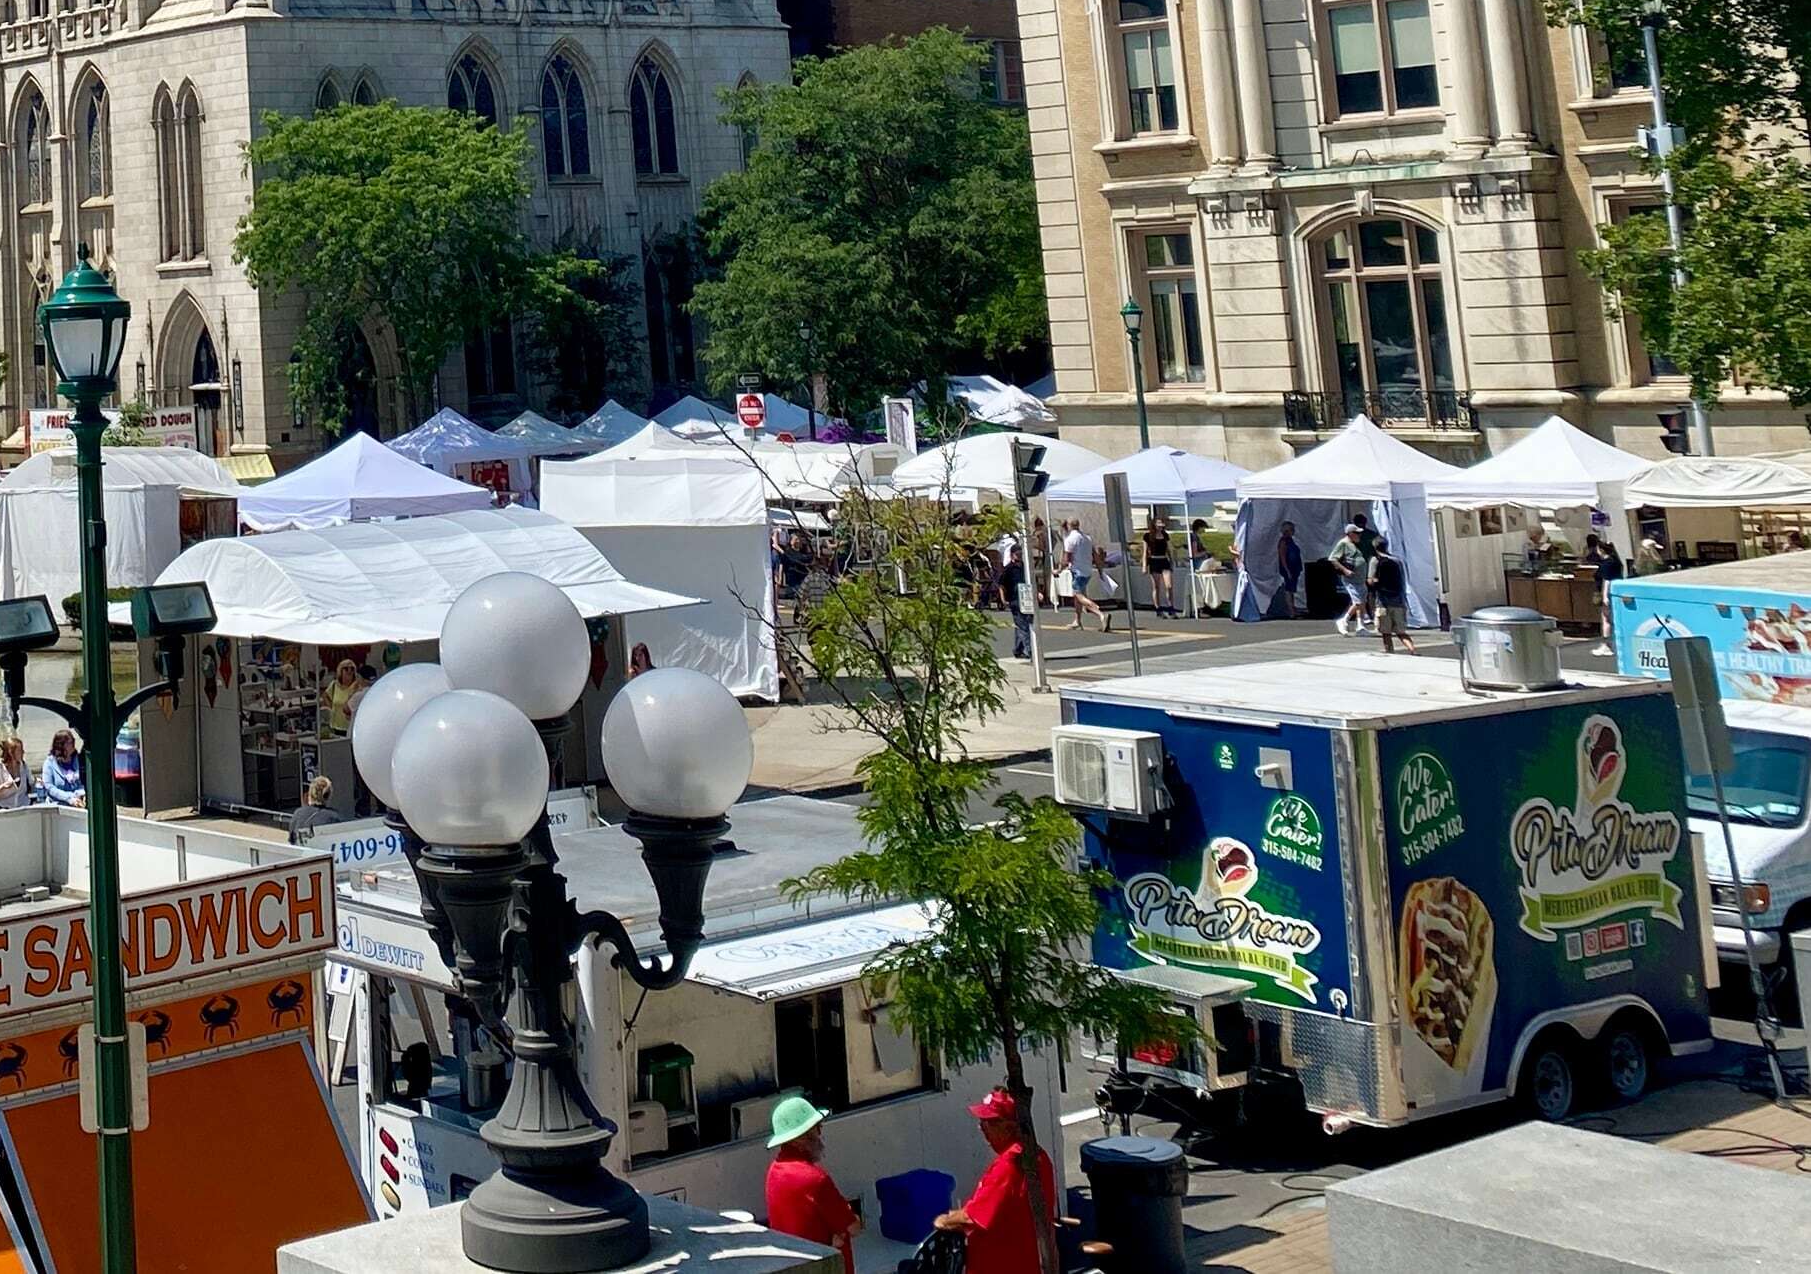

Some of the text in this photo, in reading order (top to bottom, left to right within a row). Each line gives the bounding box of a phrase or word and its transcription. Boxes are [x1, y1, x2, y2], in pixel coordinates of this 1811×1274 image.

[160, 412, 193, 427] DOUGH
[1729, 653, 1785, 674] HEALTHY
[1398, 758, 1455, 836] We Cater!
[1267, 813, 1323, 851] Cater!
[1515, 803, 1678, 889] Pita Dream
[1128, 876, 1316, 949] Pita Dream
[337, 916, 426, 973] el DEWITT
[409, 1173, 446, 1196] SUNDAES
